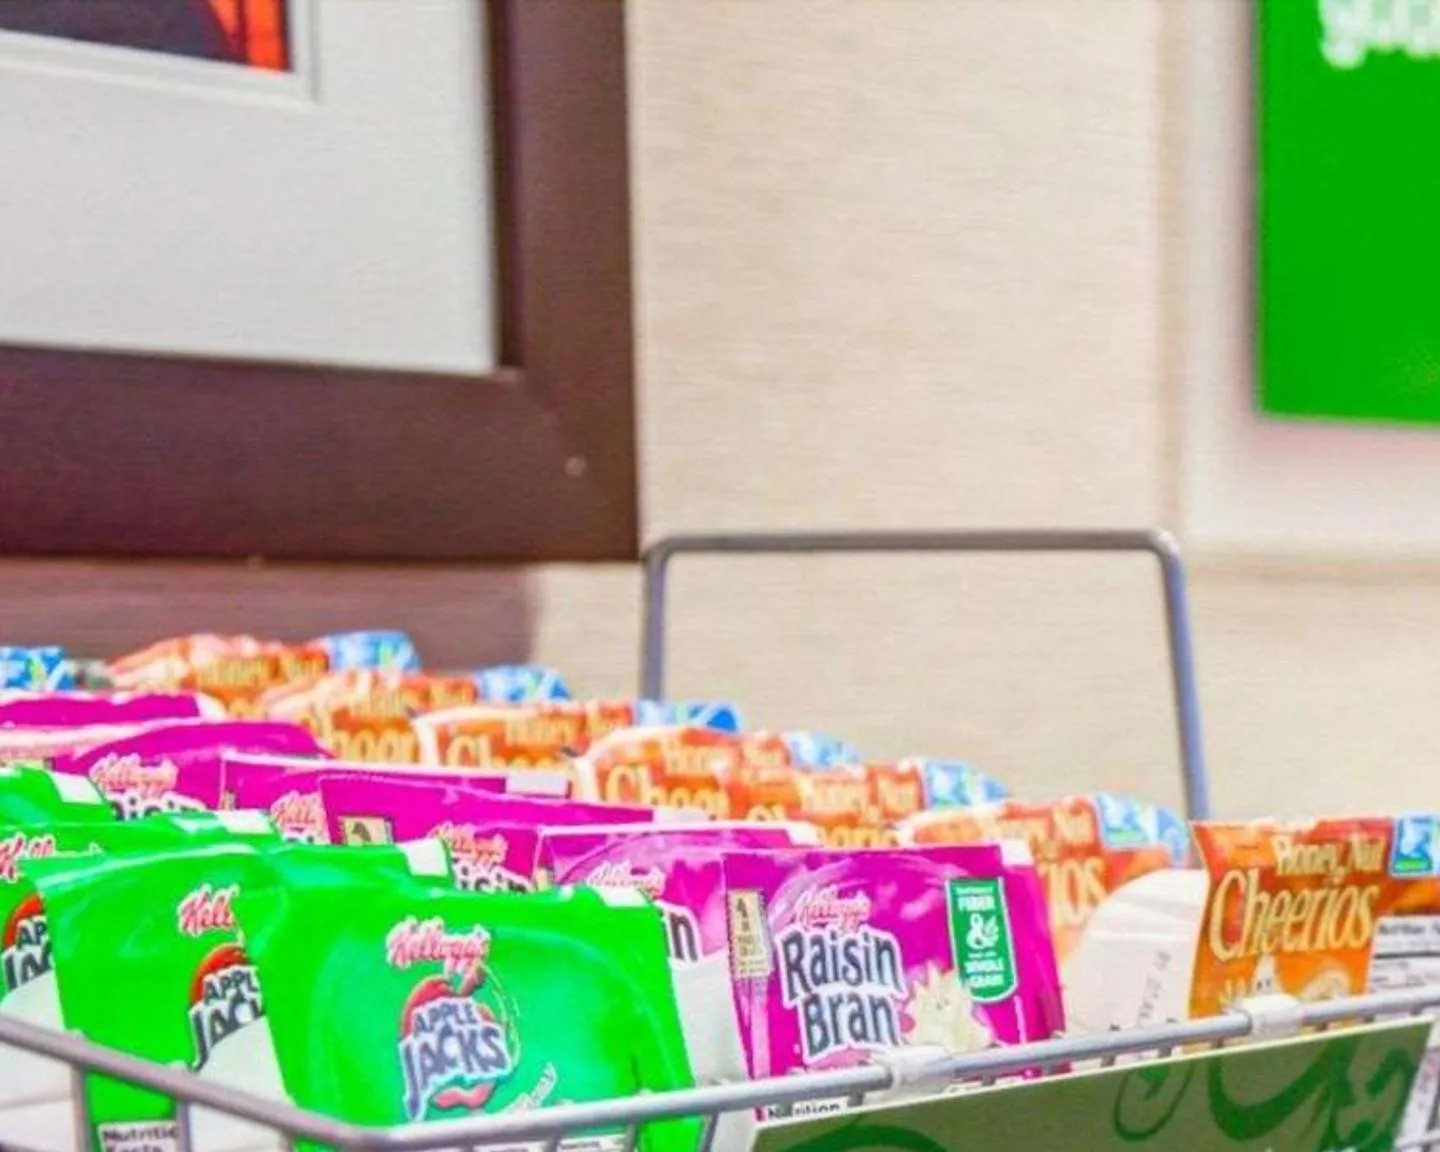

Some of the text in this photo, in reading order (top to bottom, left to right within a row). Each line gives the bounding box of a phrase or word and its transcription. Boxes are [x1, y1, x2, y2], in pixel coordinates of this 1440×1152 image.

[1210, 868, 1381, 962] Cheerios
[782, 930, 905, 1001] Raisin
[413, 1002, 478, 1037] APPLE
[803, 992, 899, 1058] Bran
[403, 1023, 510, 1120] JACKS
[103, 1127, 178, 1143] Nutriti
